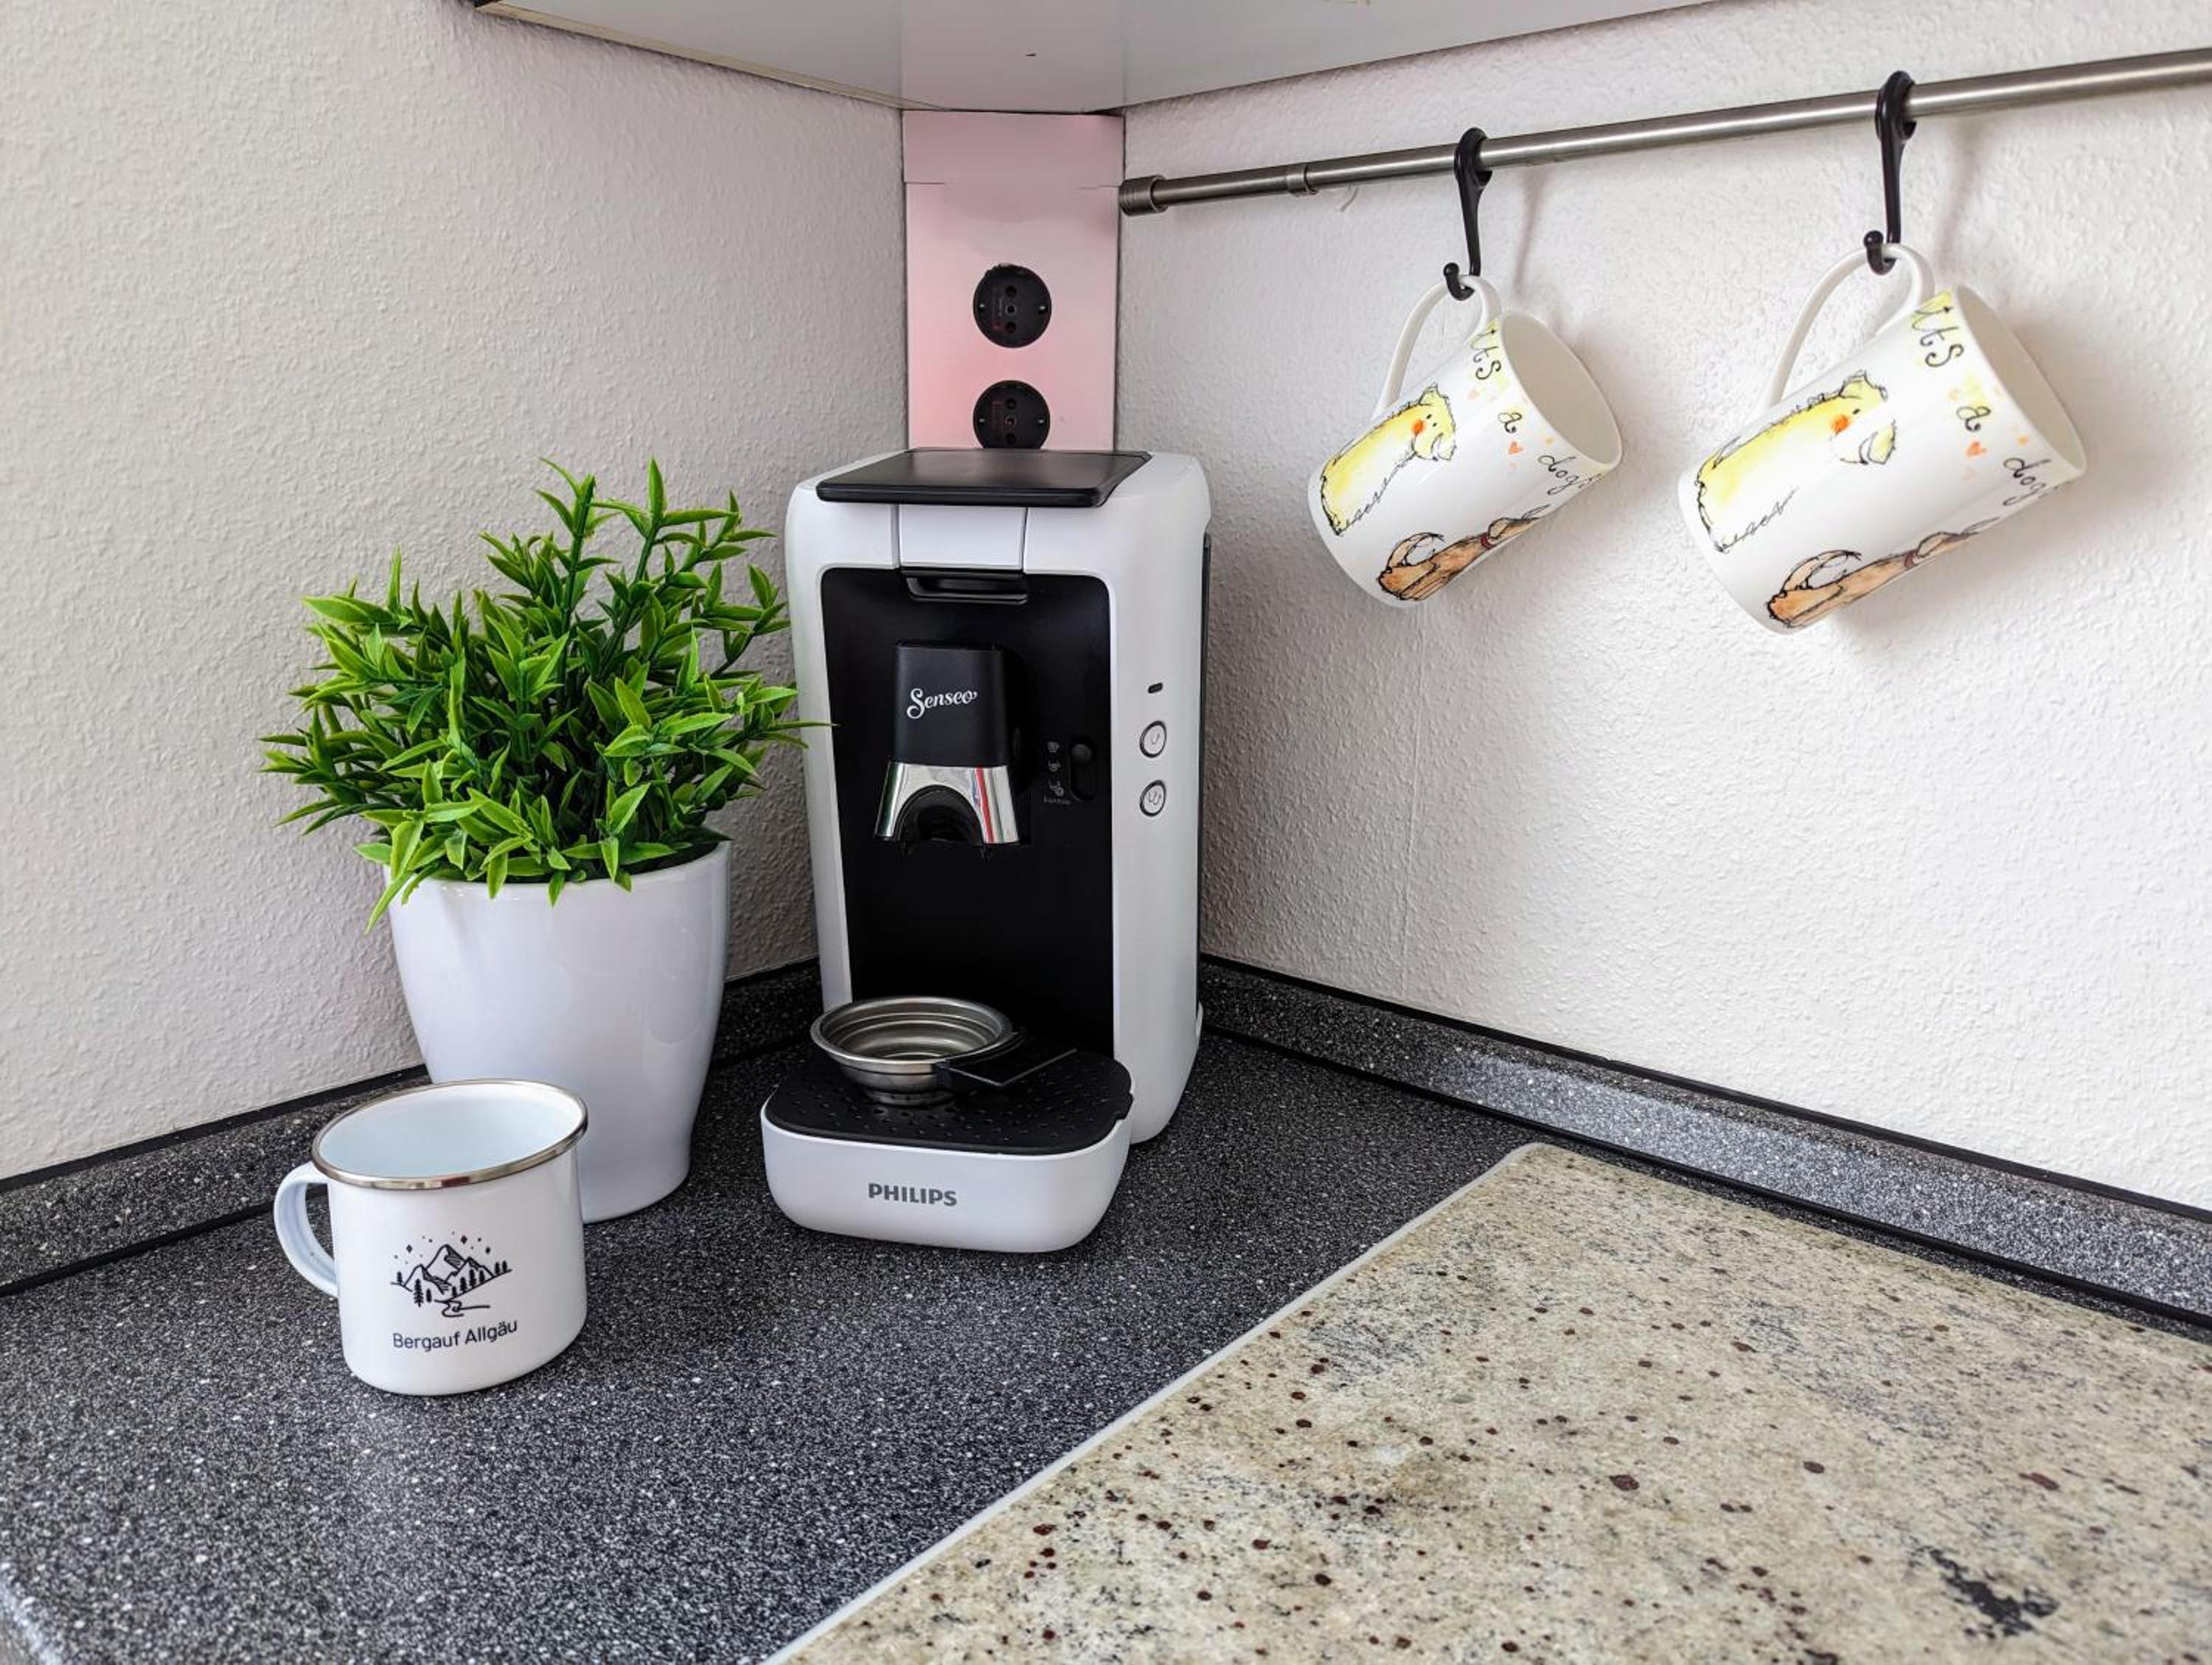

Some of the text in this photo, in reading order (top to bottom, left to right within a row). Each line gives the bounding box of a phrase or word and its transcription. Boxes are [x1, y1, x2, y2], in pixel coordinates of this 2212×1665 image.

[1498, 411, 1523, 434] a
[1956, 406, 1992, 433] a
[906, 687, 978, 720] Senseo
[868, 1182, 958, 1207] PHILIPS
[393, 1320, 518, 1352] Bergauf Allgäu
